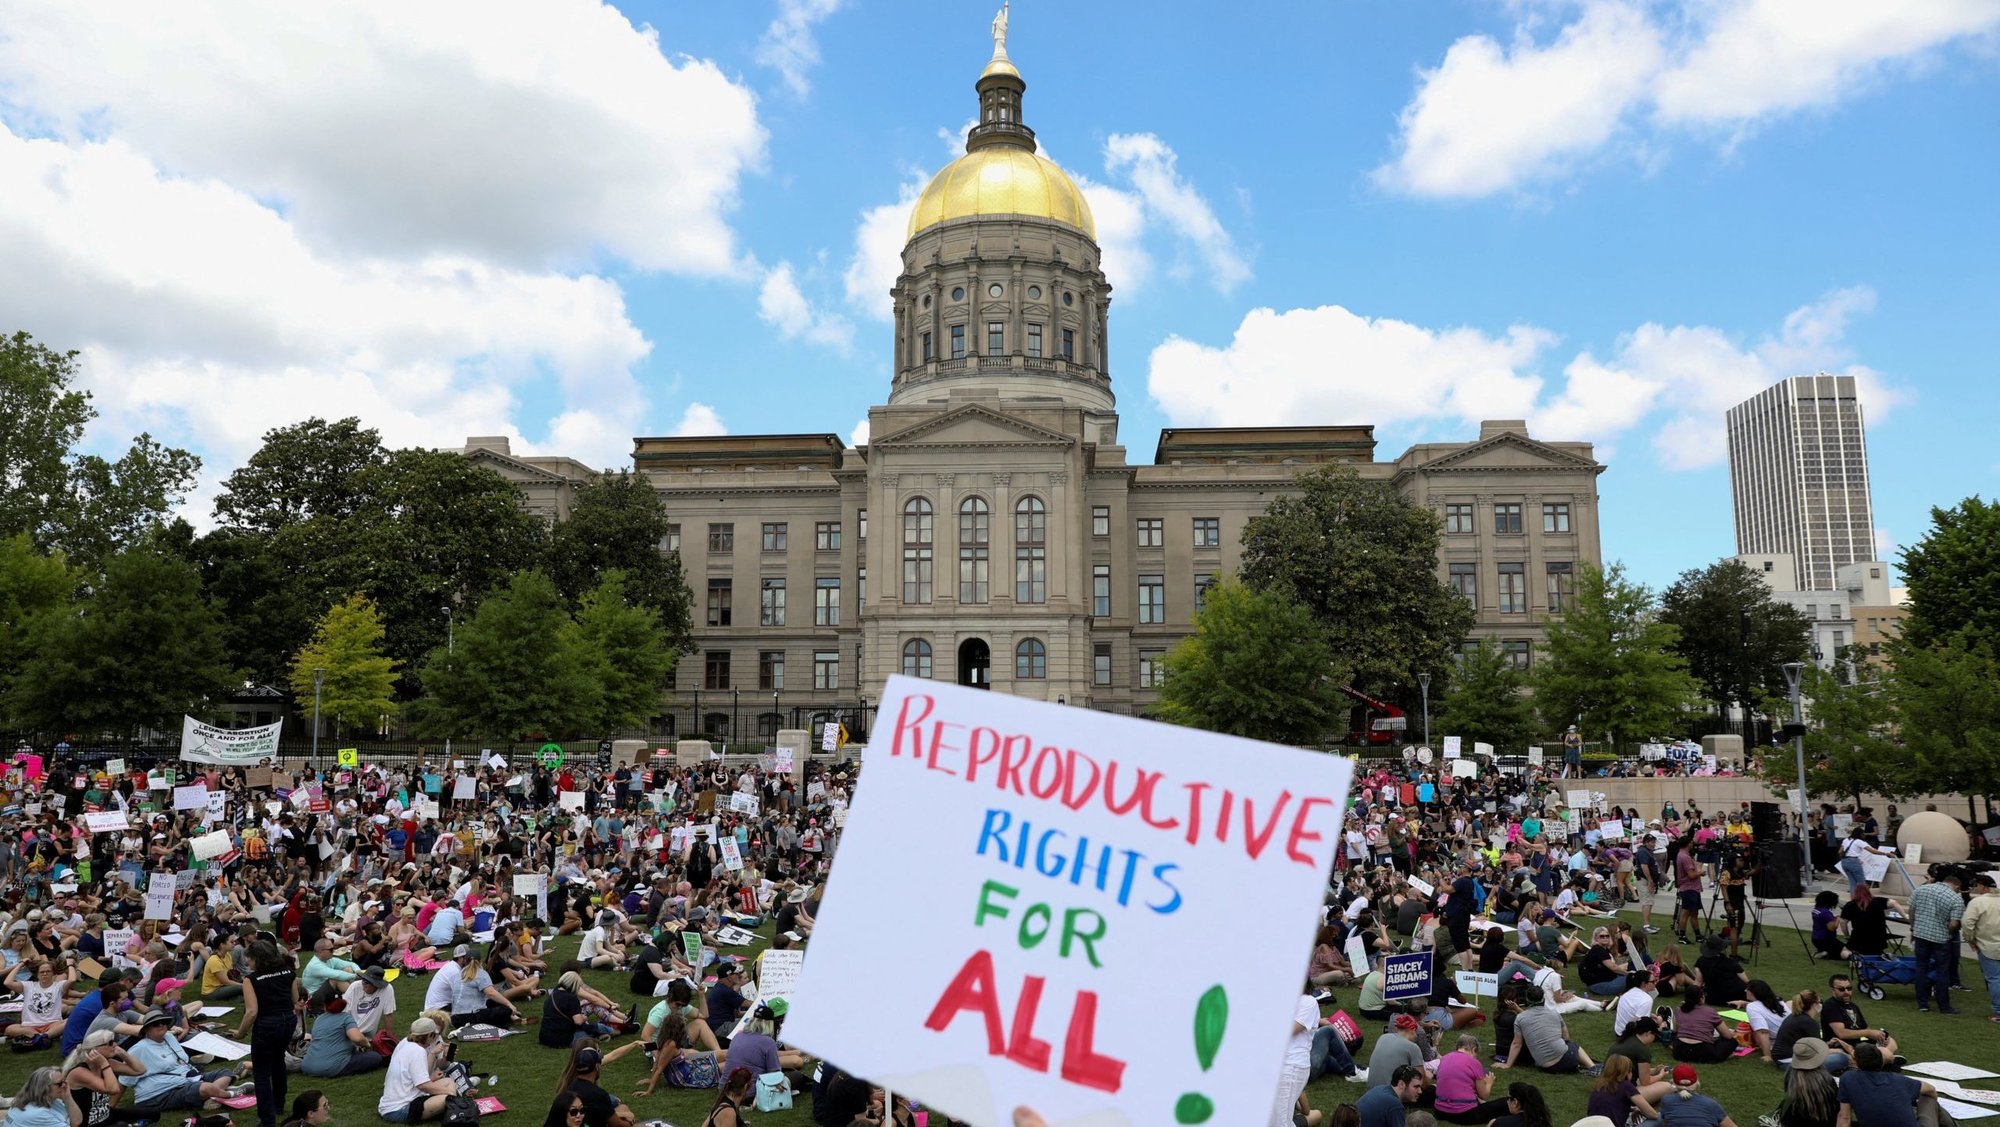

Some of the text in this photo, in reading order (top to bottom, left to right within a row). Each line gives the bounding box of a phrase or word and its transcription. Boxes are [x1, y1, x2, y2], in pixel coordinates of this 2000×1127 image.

[192, 728, 215, 739] ONCE
[198, 724, 270, 736] LEGAL ABORTION
[1665, 746, 1699, 762] FOX 5
[890, 694, 1334, 868] REPRODUCTIVE
[976, 809, 1183, 915] RIGHTS
[974, 879, 1107, 968] FOR
[1387, 960, 1423, 974] STACEY
[1386, 970, 1428, 985] ABRAMS
[1386, 982, 1419, 992] GOVERNOR
[924, 949, 1127, 1093] ALL
